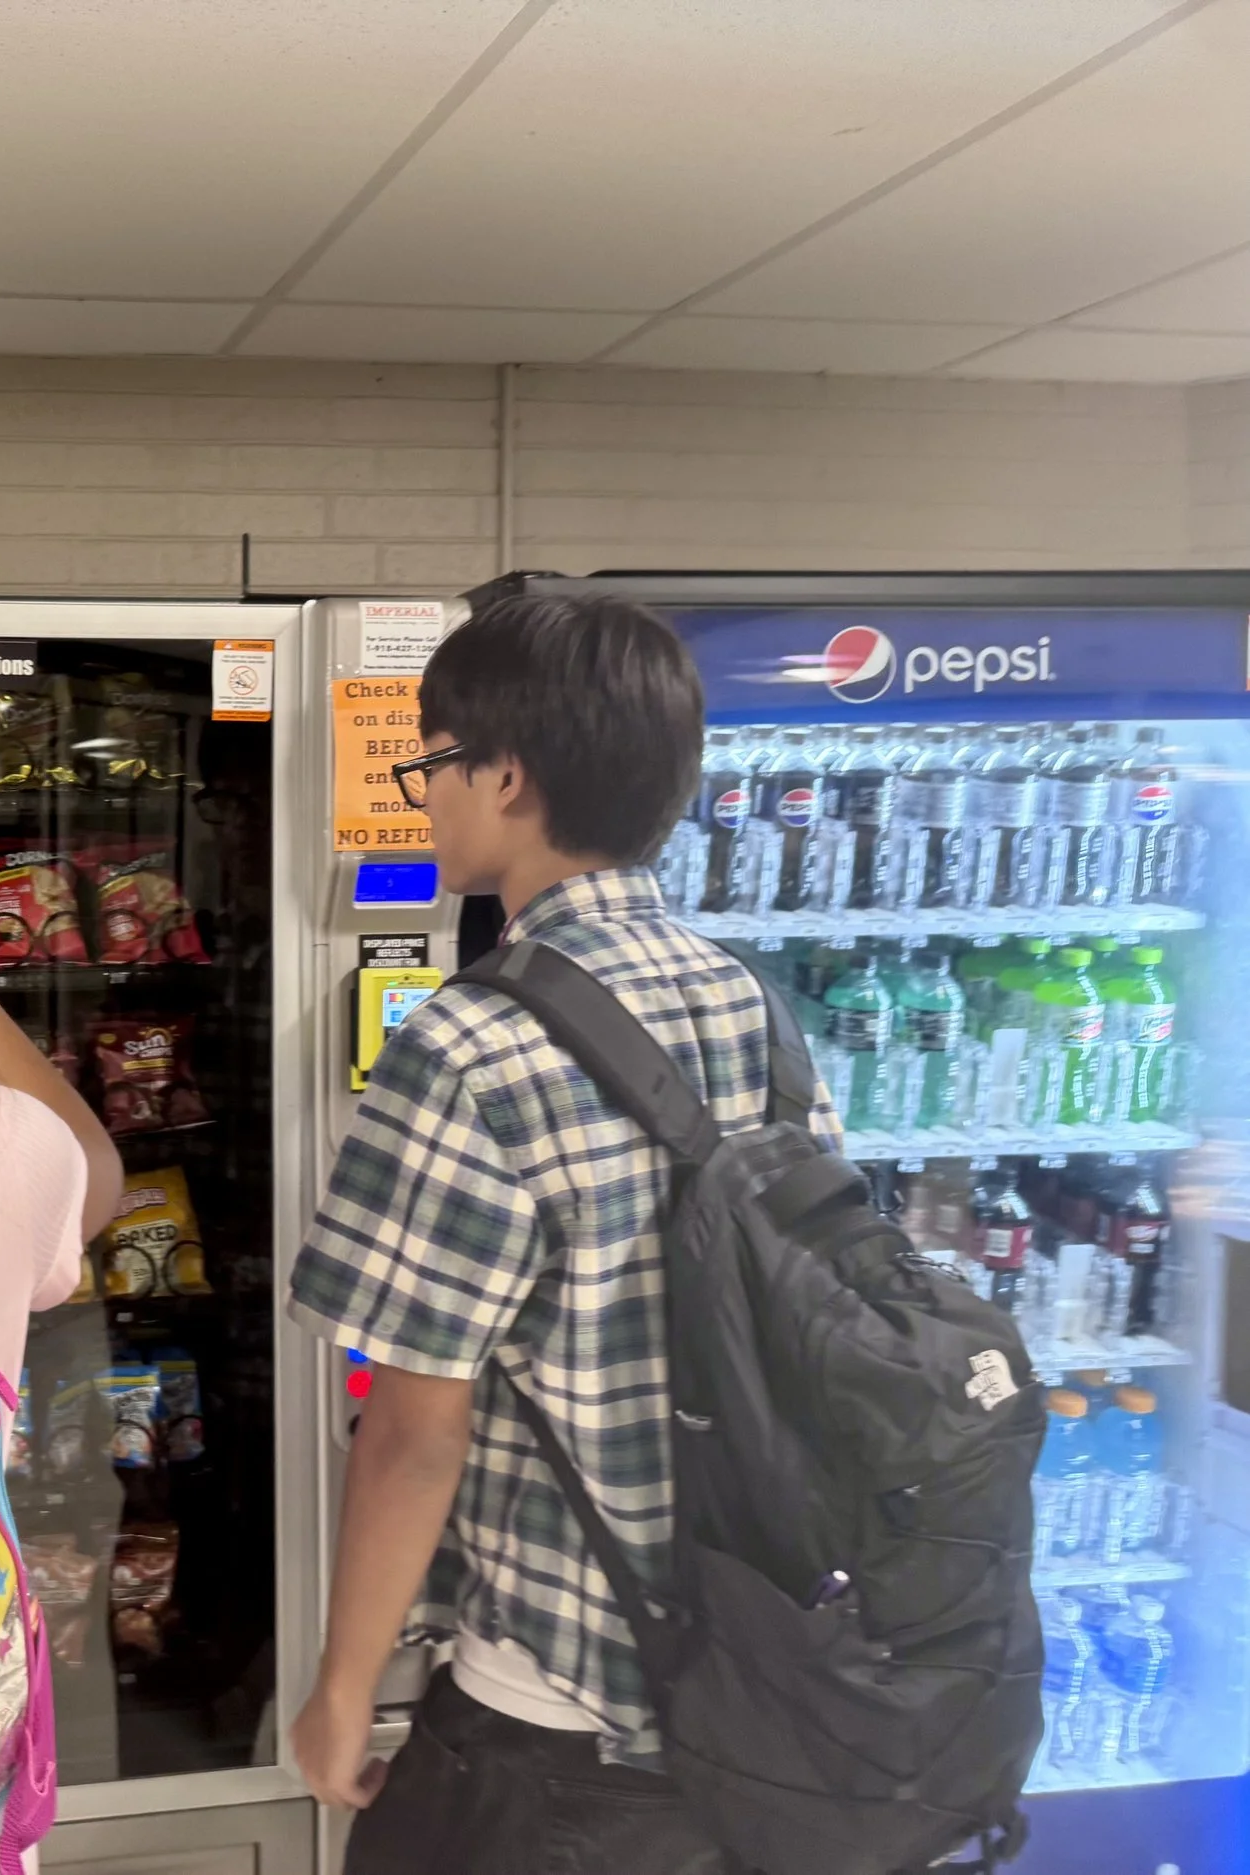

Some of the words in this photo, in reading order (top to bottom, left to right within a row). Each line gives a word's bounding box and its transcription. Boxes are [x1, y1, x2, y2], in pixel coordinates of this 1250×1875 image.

[365, 607, 438, 617] IMPERIAL
[904, 636, 1051, 693] pepsi
[345, 682, 409, 698] Check
[353, 715, 378, 727] on
[365, 739, 424, 755] BEFO
[337, 829, 368, 845] NO
[376, 828, 431, 844] REFU
